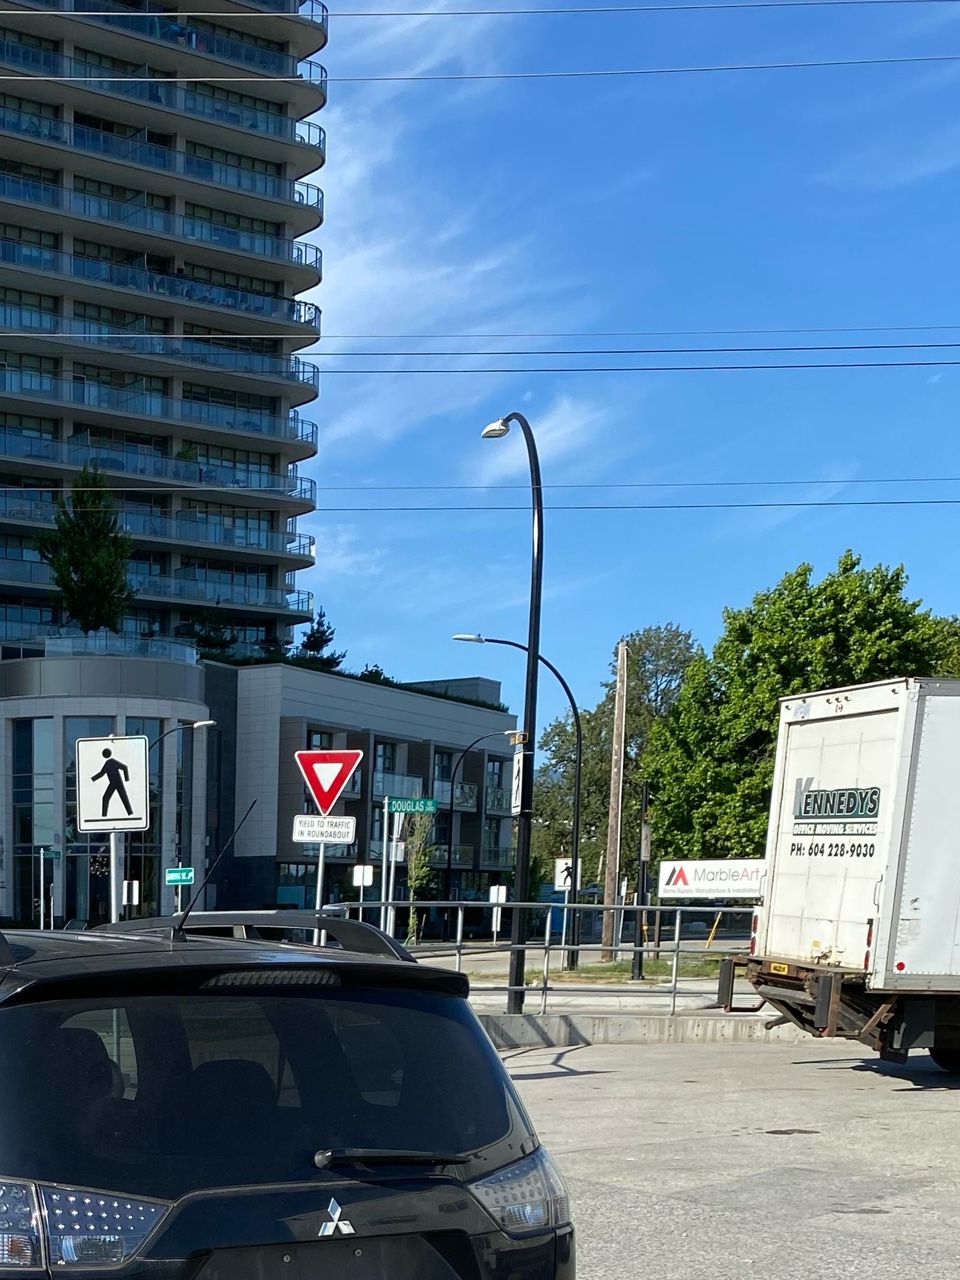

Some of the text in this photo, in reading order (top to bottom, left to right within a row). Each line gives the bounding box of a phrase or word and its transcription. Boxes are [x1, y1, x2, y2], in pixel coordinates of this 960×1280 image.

[792, 777, 880, 816] KENNEDYS
[392, 800, 424, 811] DOUGLAS
[299, 820, 351, 829] YIELD TO TRAFFIC
[793, 823, 877, 834] OFFICE MOVING SERVICES
[307, 830, 350, 839] ROUNDABOUT
[790, 843, 875, 858] PH: 604 228-9030
[693, 867, 760, 882] MarbleArt
